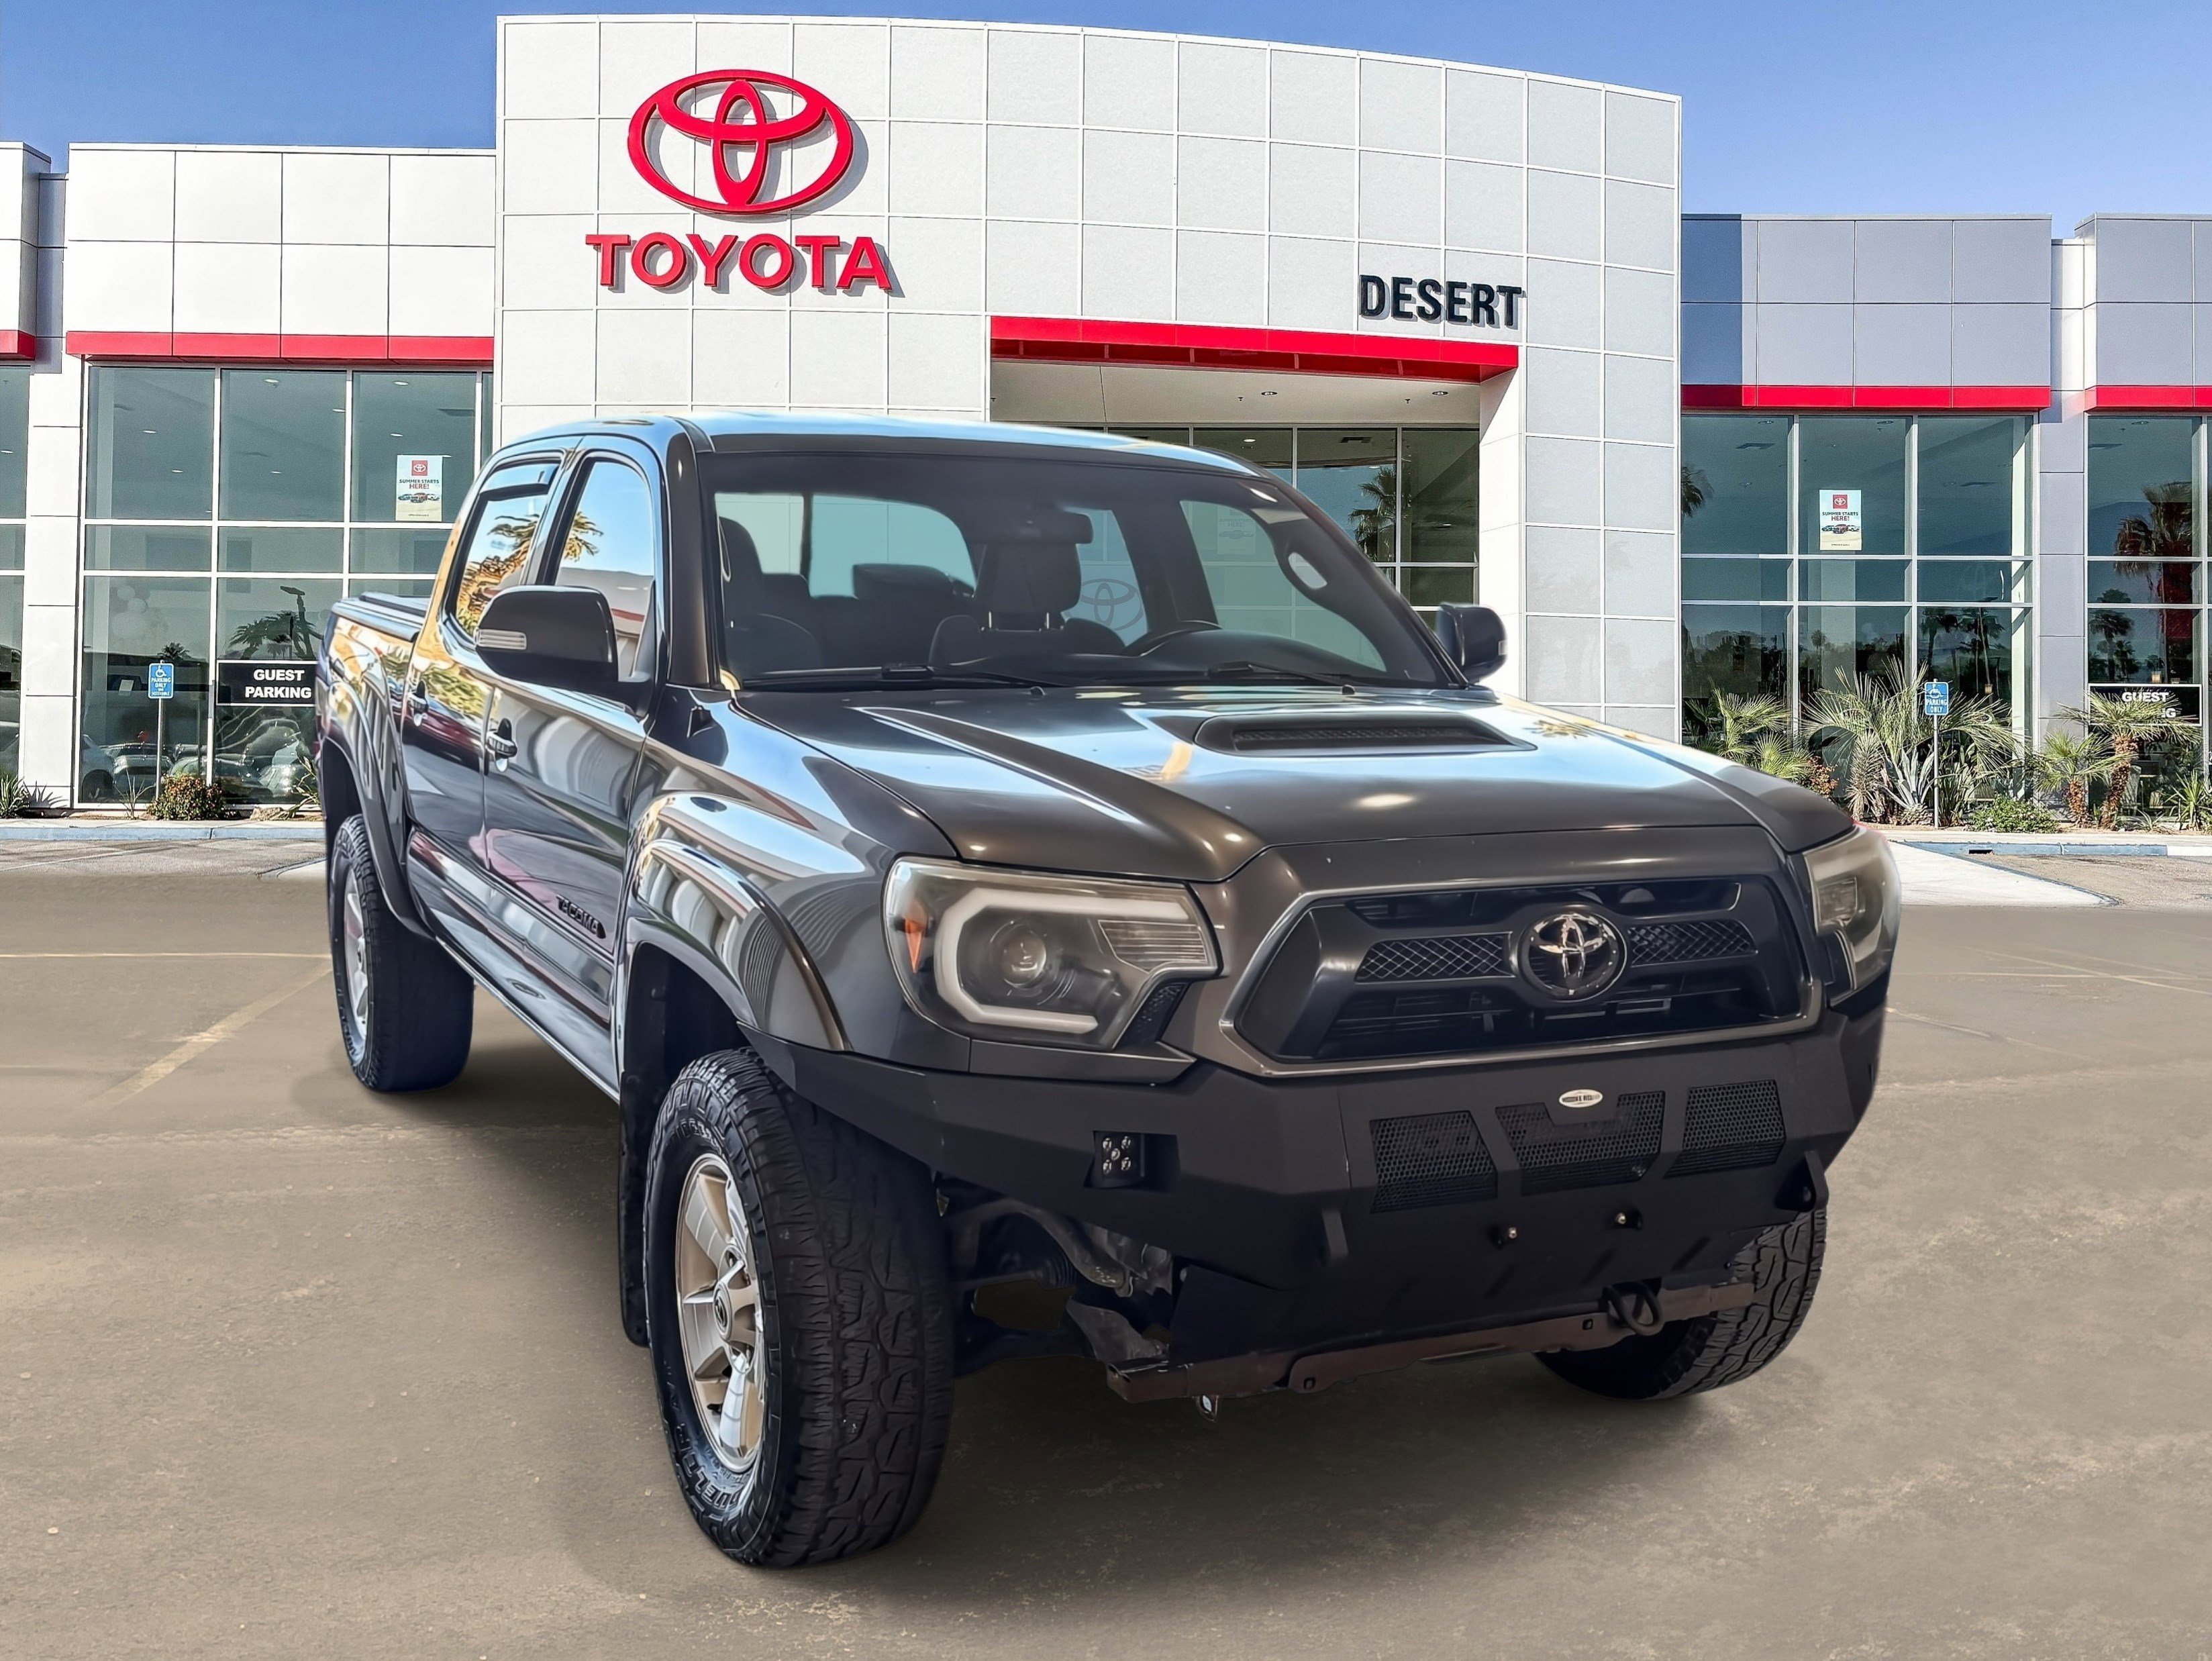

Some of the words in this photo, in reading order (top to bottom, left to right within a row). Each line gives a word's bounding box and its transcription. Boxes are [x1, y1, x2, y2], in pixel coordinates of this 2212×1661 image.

[585, 232, 894, 291] TOYOTA
[1359, 274, 1523, 327] DESERT
[254, 669, 305, 681] GUEST
[245, 687, 312, 698] PARKING
[2122, 692, 2169, 703] GUEST
